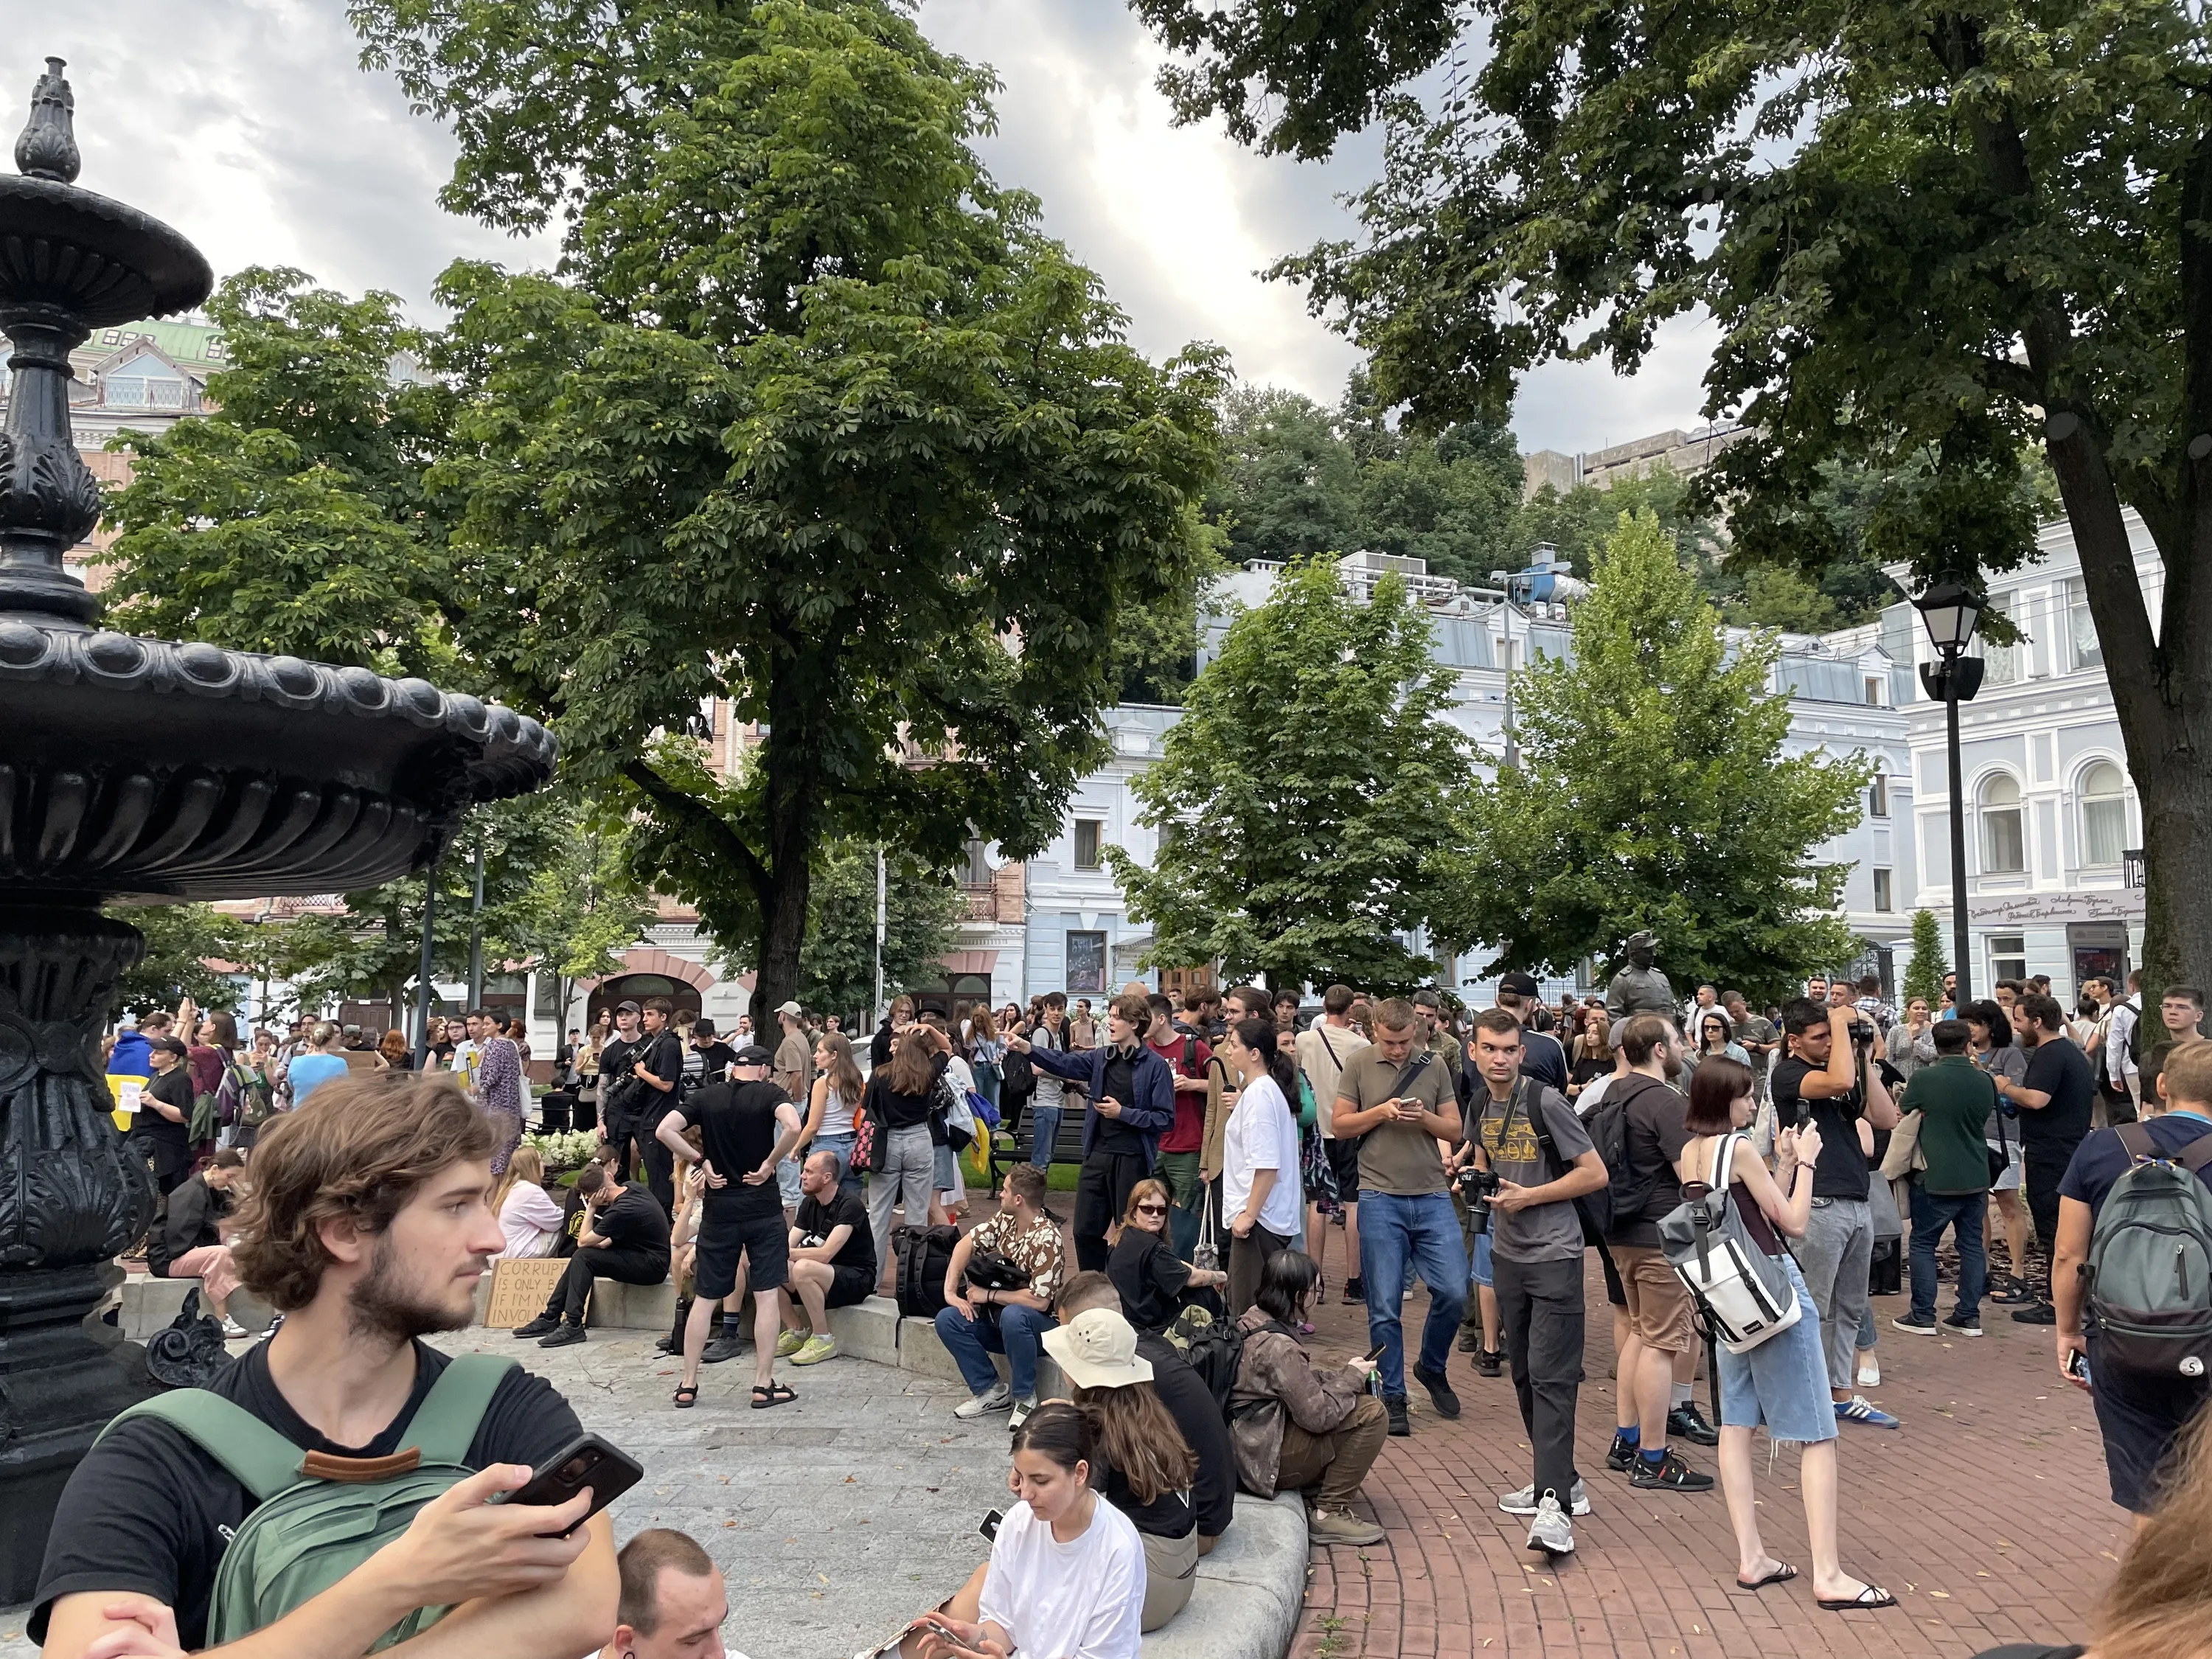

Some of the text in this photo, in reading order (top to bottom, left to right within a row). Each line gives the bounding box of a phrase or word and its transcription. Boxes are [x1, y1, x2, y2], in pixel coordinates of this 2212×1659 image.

[500, 1262, 567, 1276] CORRUPT
[498, 1278, 555, 1291] IS ONLY B
[495, 1293, 552, 1306] IF I'M NO
[493, 1309, 537, 1323] INVOL
[2188, 1362, 2196, 1373] S
